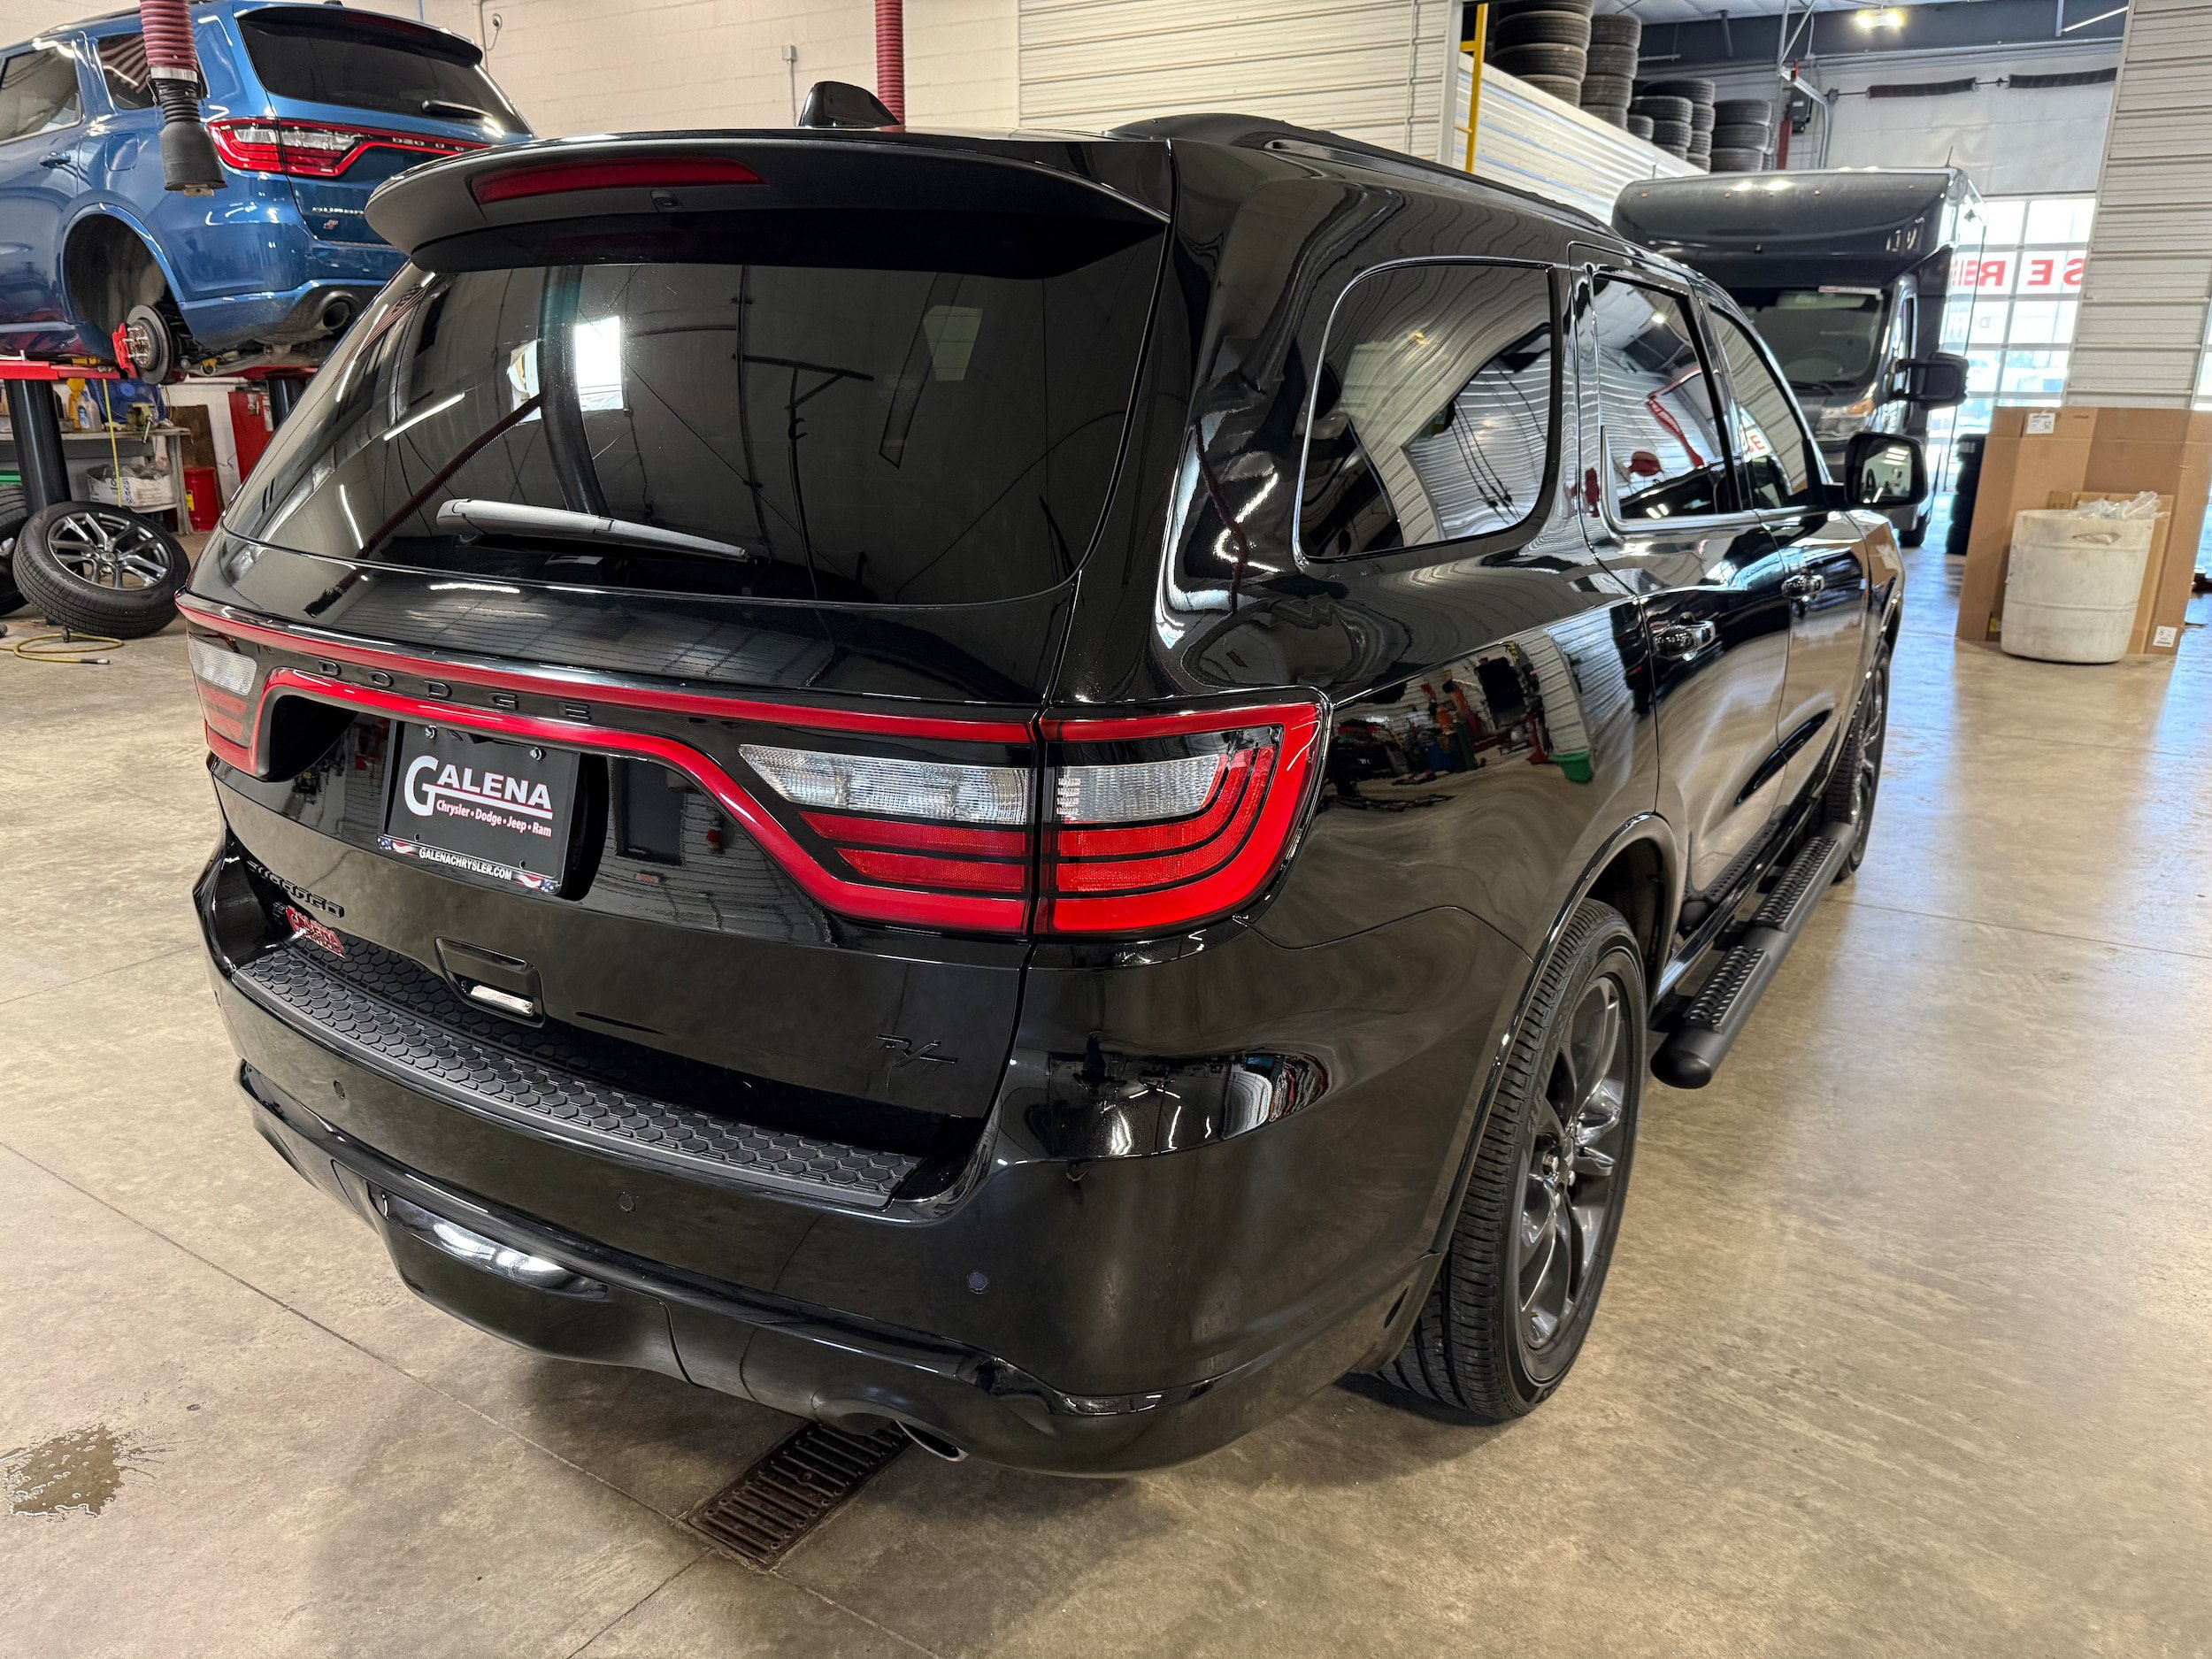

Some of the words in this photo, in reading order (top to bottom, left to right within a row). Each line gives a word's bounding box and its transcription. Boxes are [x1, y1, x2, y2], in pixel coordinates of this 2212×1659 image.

[319, 659, 591, 721] DODGE
[403, 755, 553, 817] GALENA
[436, 799, 471, 817] Chrysler
[475, 808, 503, 826] Dodge
[506, 816, 527, 833] Jeep
[532, 821, 552, 837] Ram
[419, 846, 513, 881] GALENACHRYSLER.COM
[866, 1033, 959, 1090] R/T
